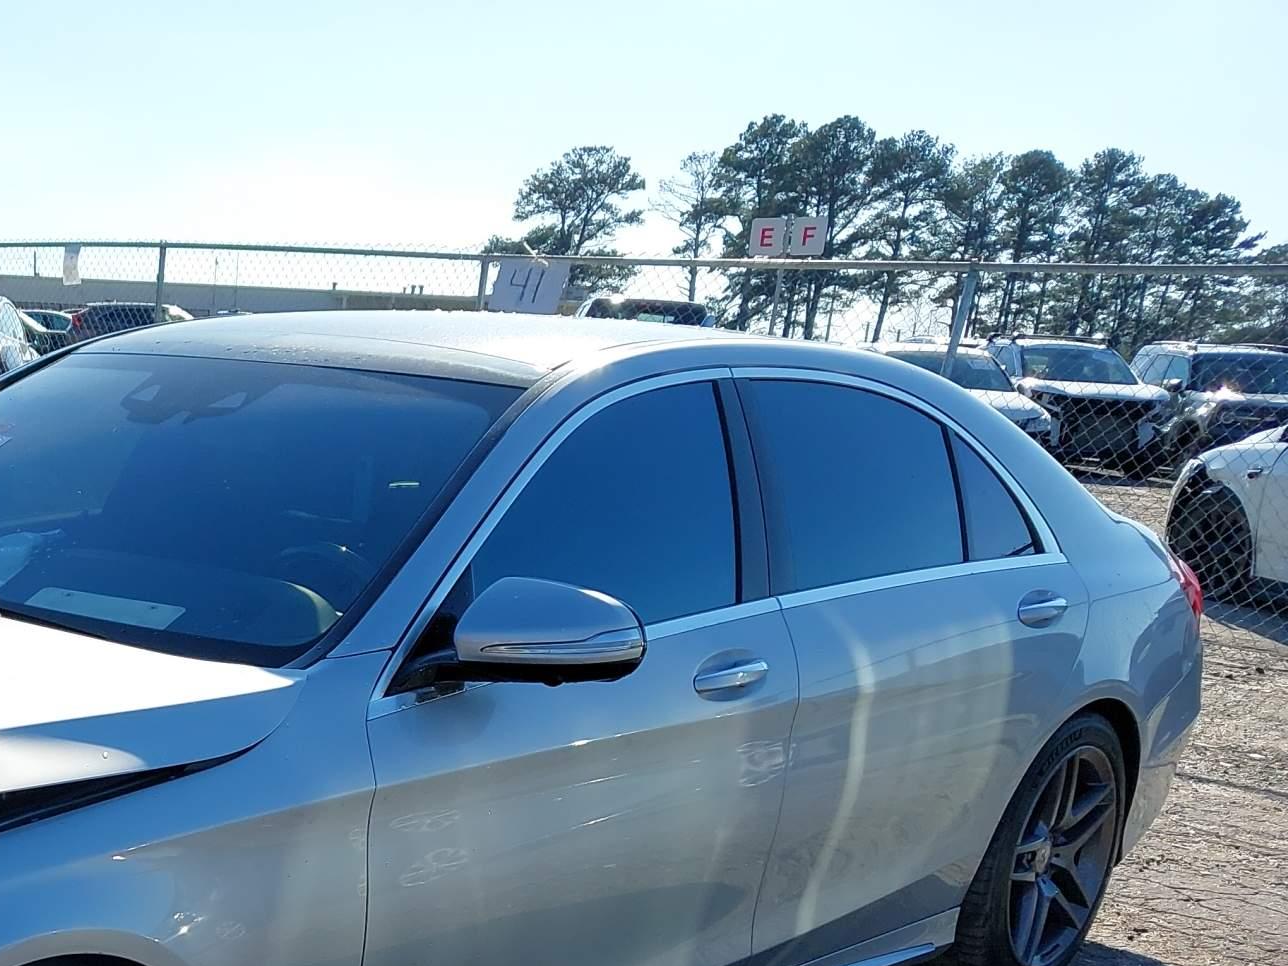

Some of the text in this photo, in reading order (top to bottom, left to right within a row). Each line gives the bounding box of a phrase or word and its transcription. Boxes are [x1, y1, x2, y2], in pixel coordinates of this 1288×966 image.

[759, 227, 775, 247] E
[801, 226, 817, 246] F
[510, 267, 546, 304] 41
